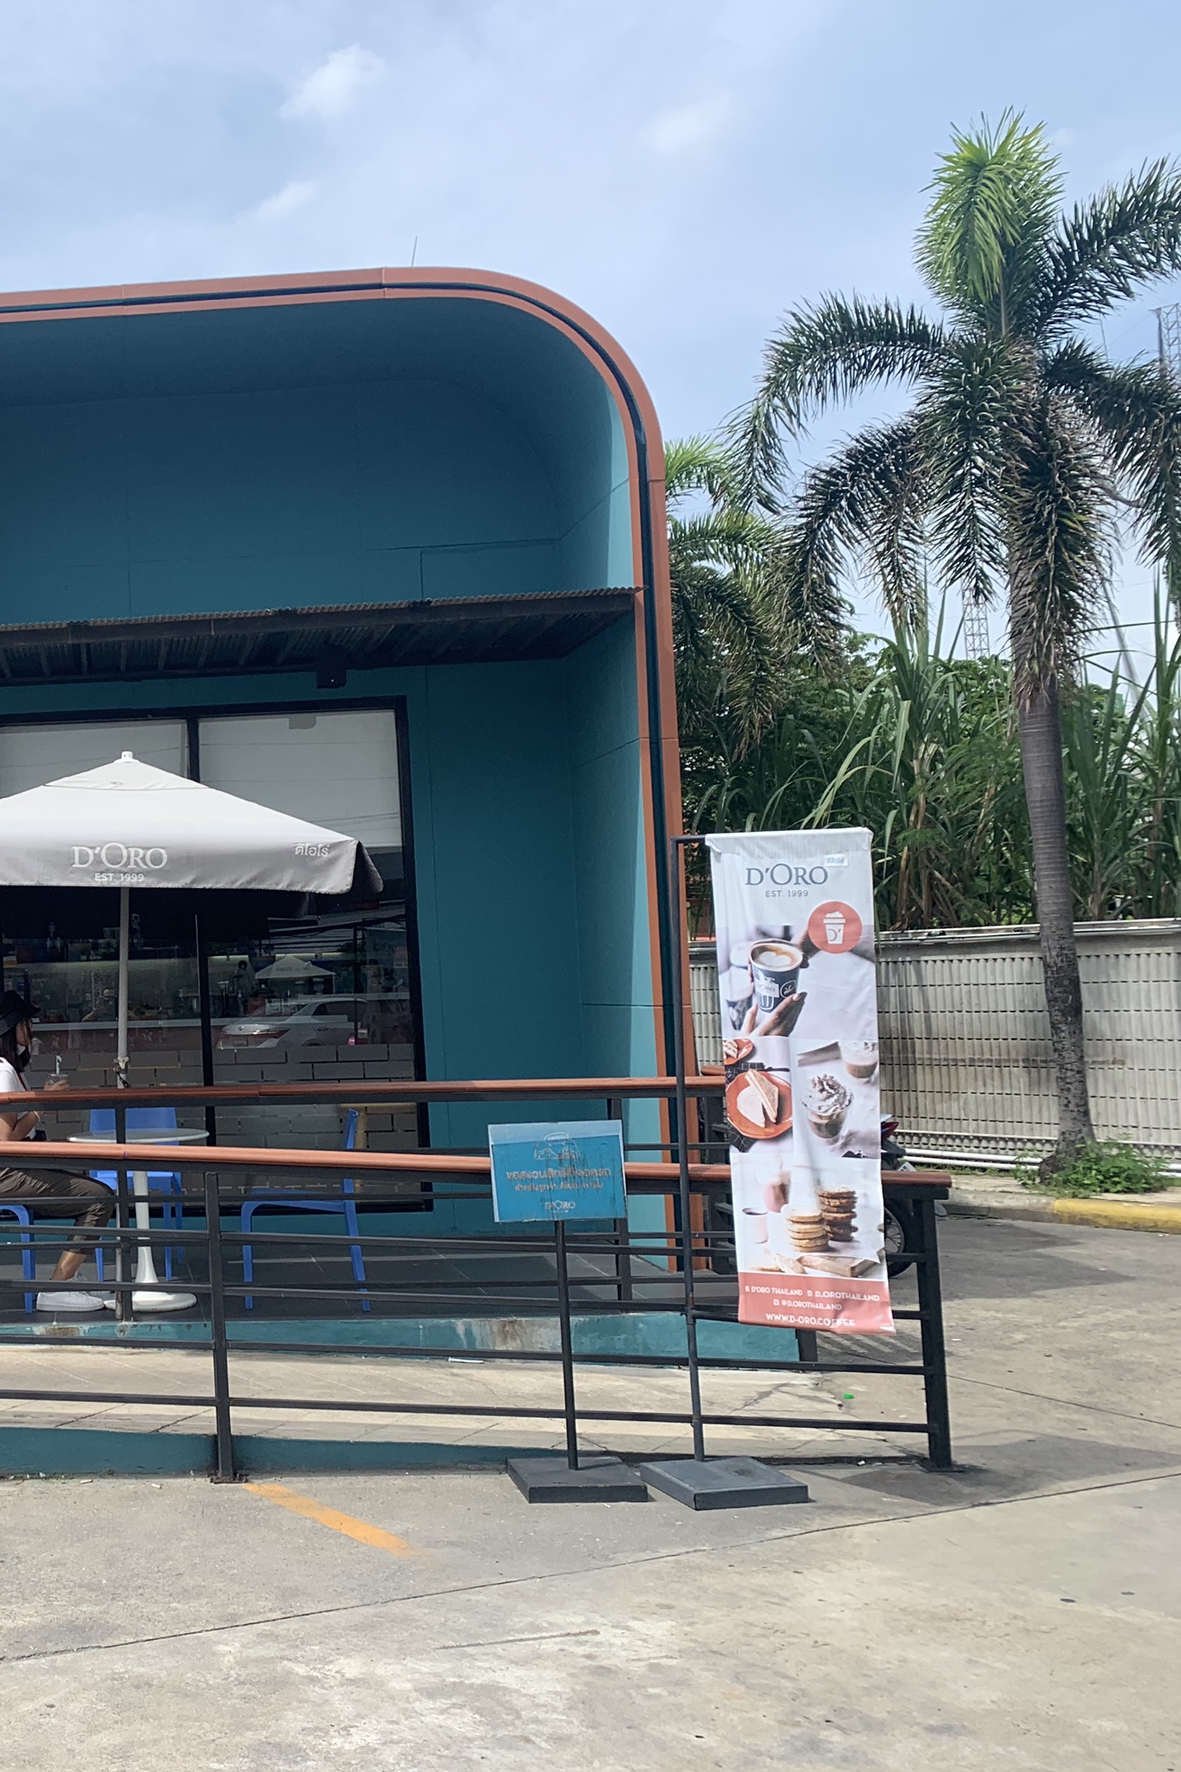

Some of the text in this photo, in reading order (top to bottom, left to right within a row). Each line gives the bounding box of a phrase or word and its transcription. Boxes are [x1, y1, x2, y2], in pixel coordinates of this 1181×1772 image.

[71, 842, 168, 869] D'ORO
[120, 873, 144, 882] 1999
[745, 863, 829, 886] D'ORO
[765, 889, 809, 898] EST. 1999
[772, 1286, 803, 1296] THAILAND
